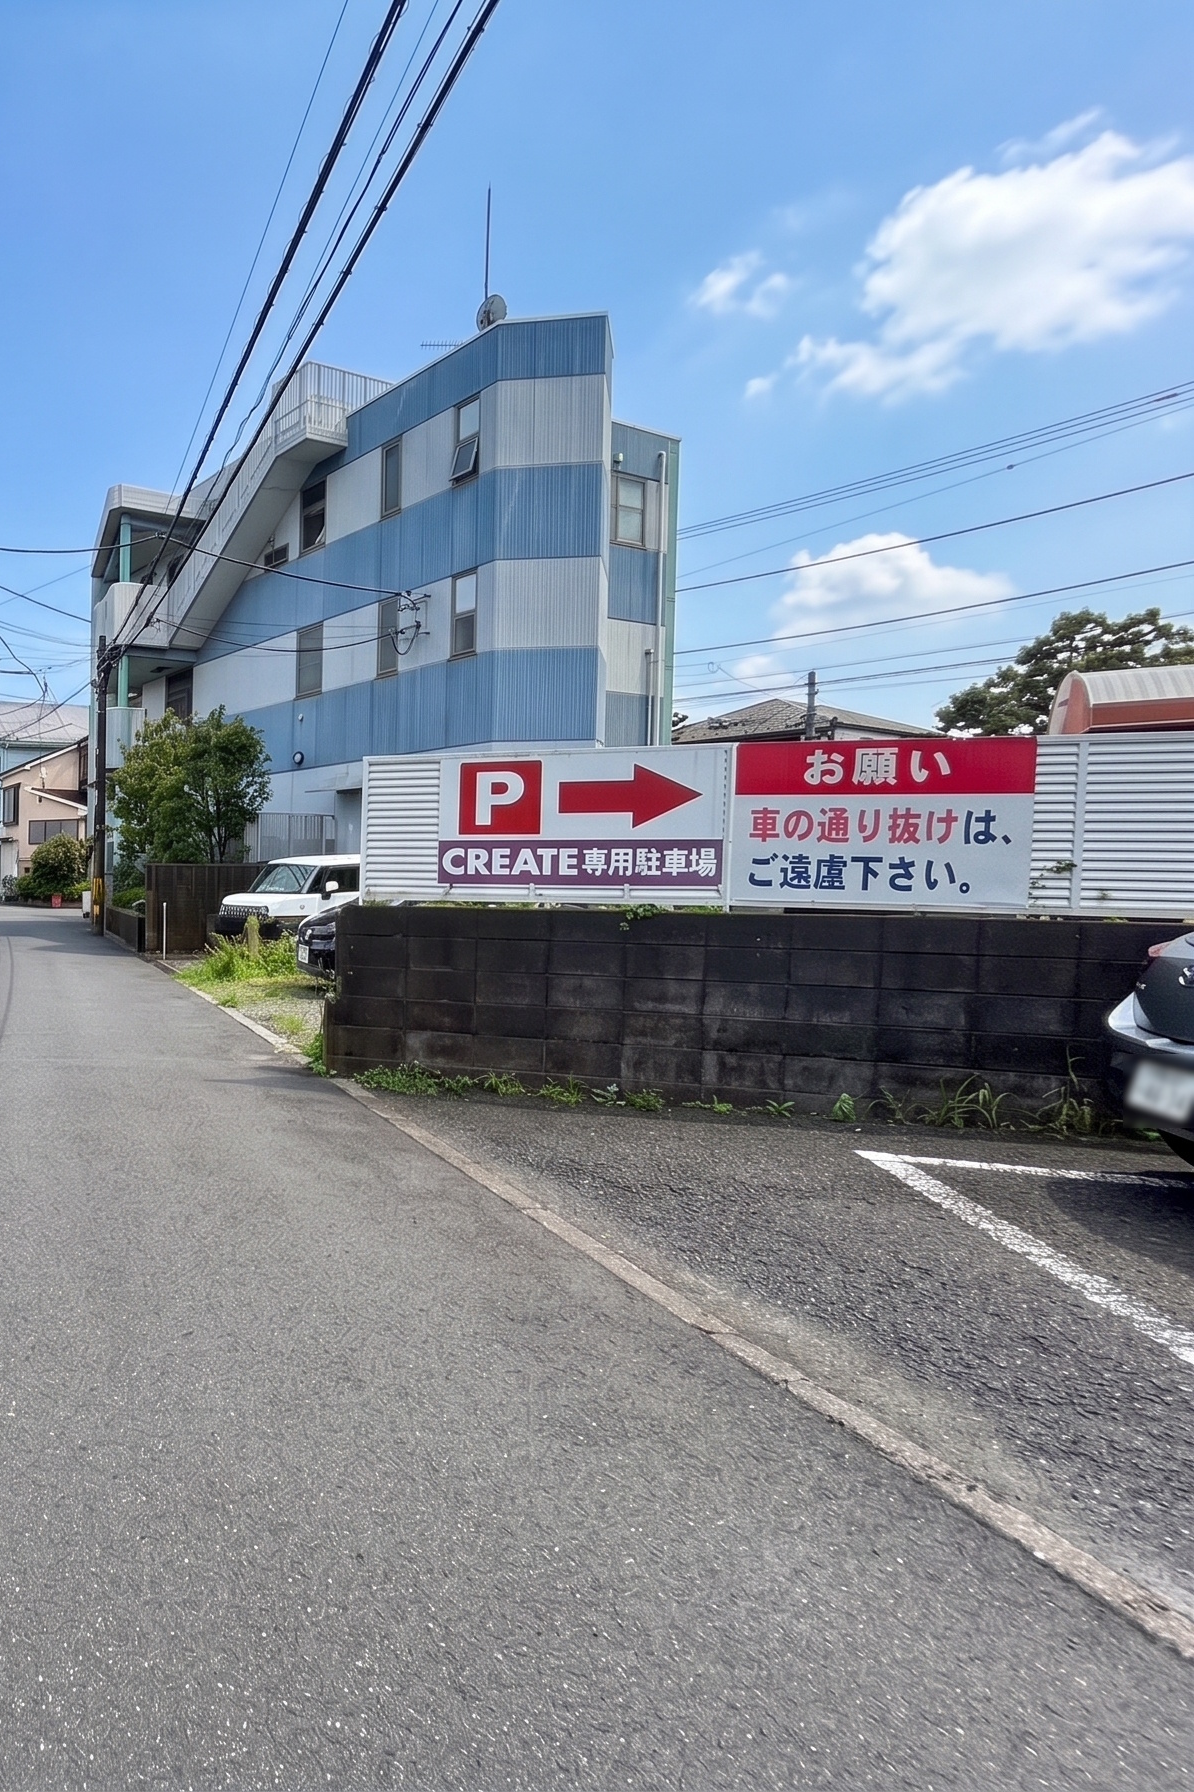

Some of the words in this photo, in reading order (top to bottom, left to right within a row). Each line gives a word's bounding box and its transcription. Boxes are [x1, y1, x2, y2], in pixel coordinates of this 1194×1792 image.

[803, 746, 952, 786] お願い
[475, 770, 525, 826] P
[748, 806, 1012, 845] 車の通り抜けは、
